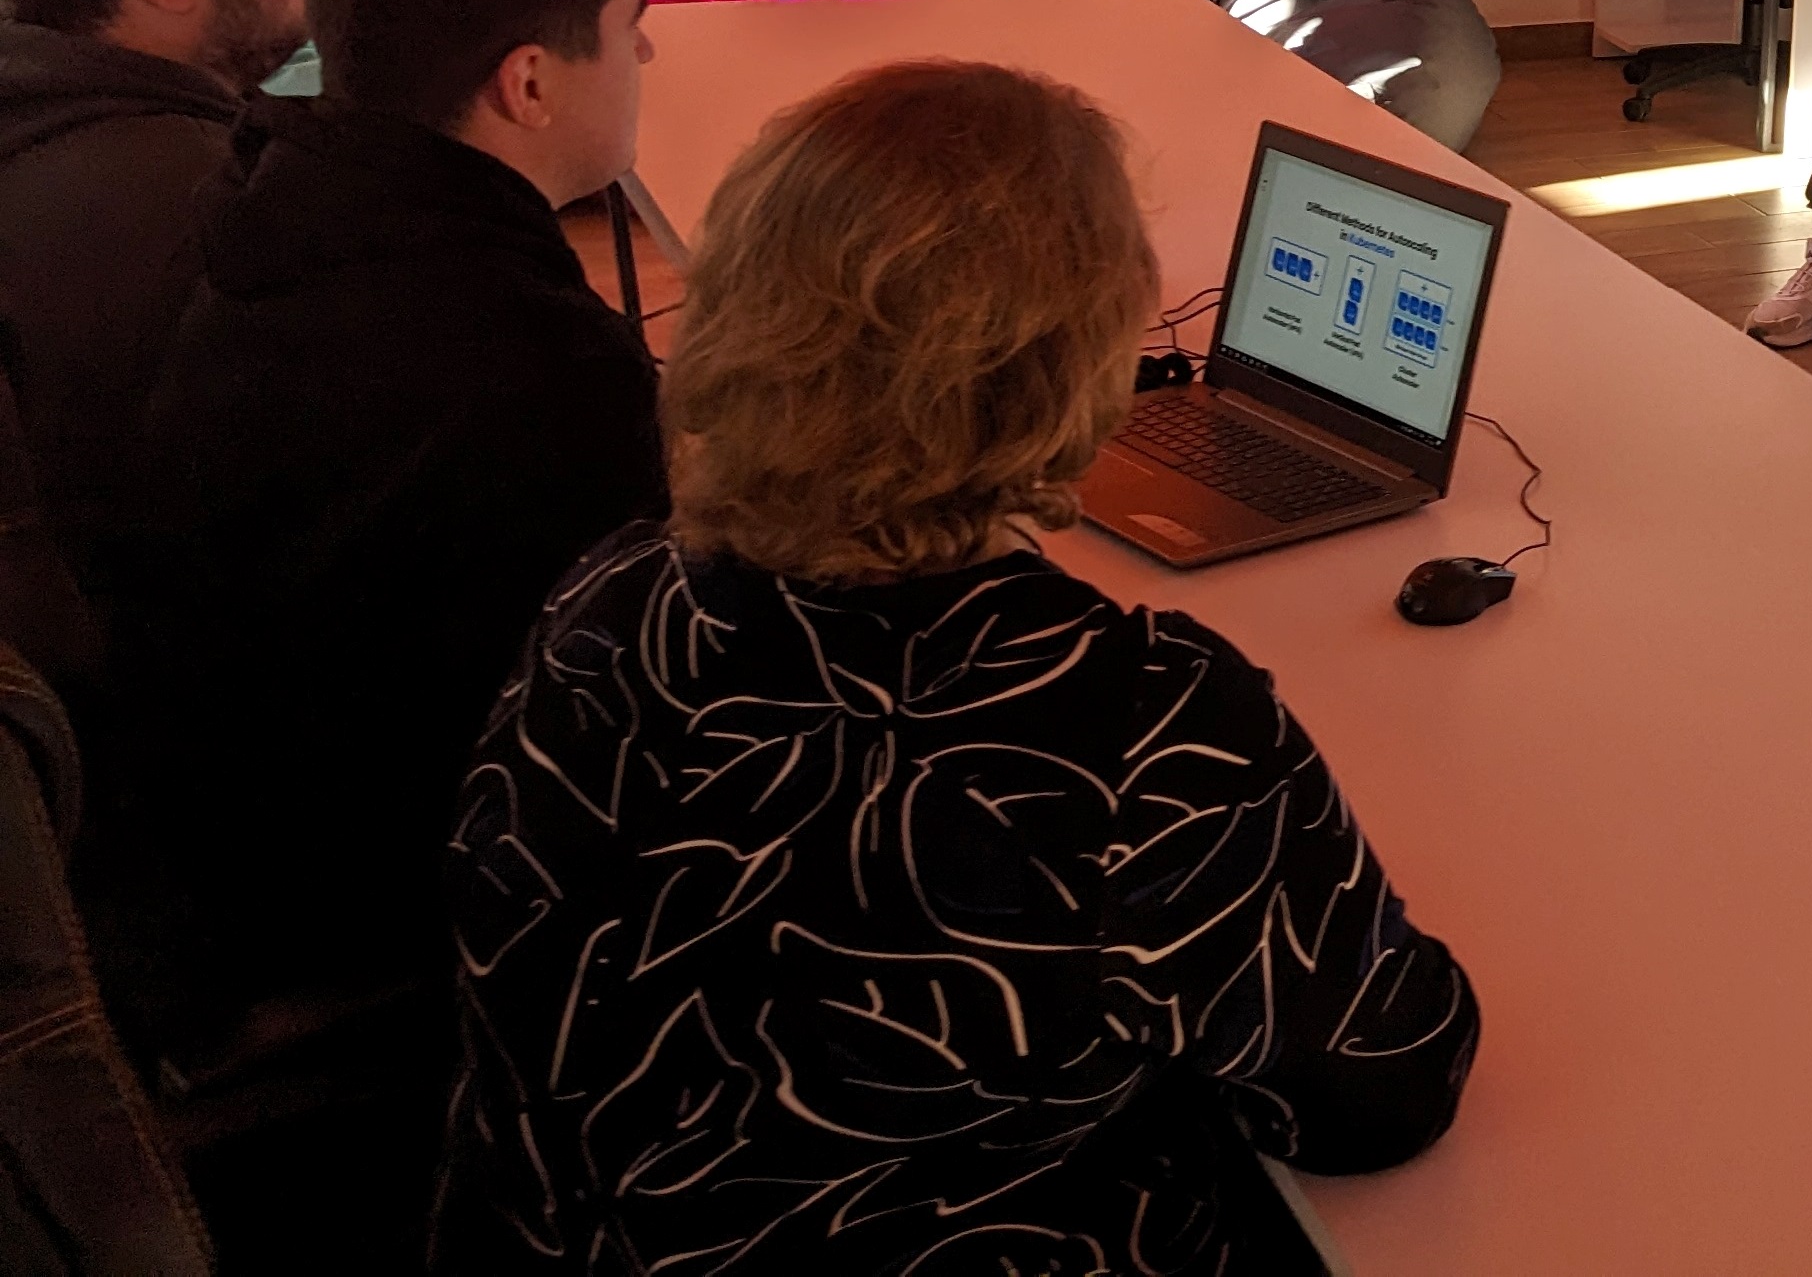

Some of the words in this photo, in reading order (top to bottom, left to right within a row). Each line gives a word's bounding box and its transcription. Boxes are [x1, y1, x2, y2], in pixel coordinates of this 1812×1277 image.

[1306, 202, 1341, 222] Different
[1341, 213, 1375, 235] Methods
[1388, 231, 1438, 260] Autoscaling
